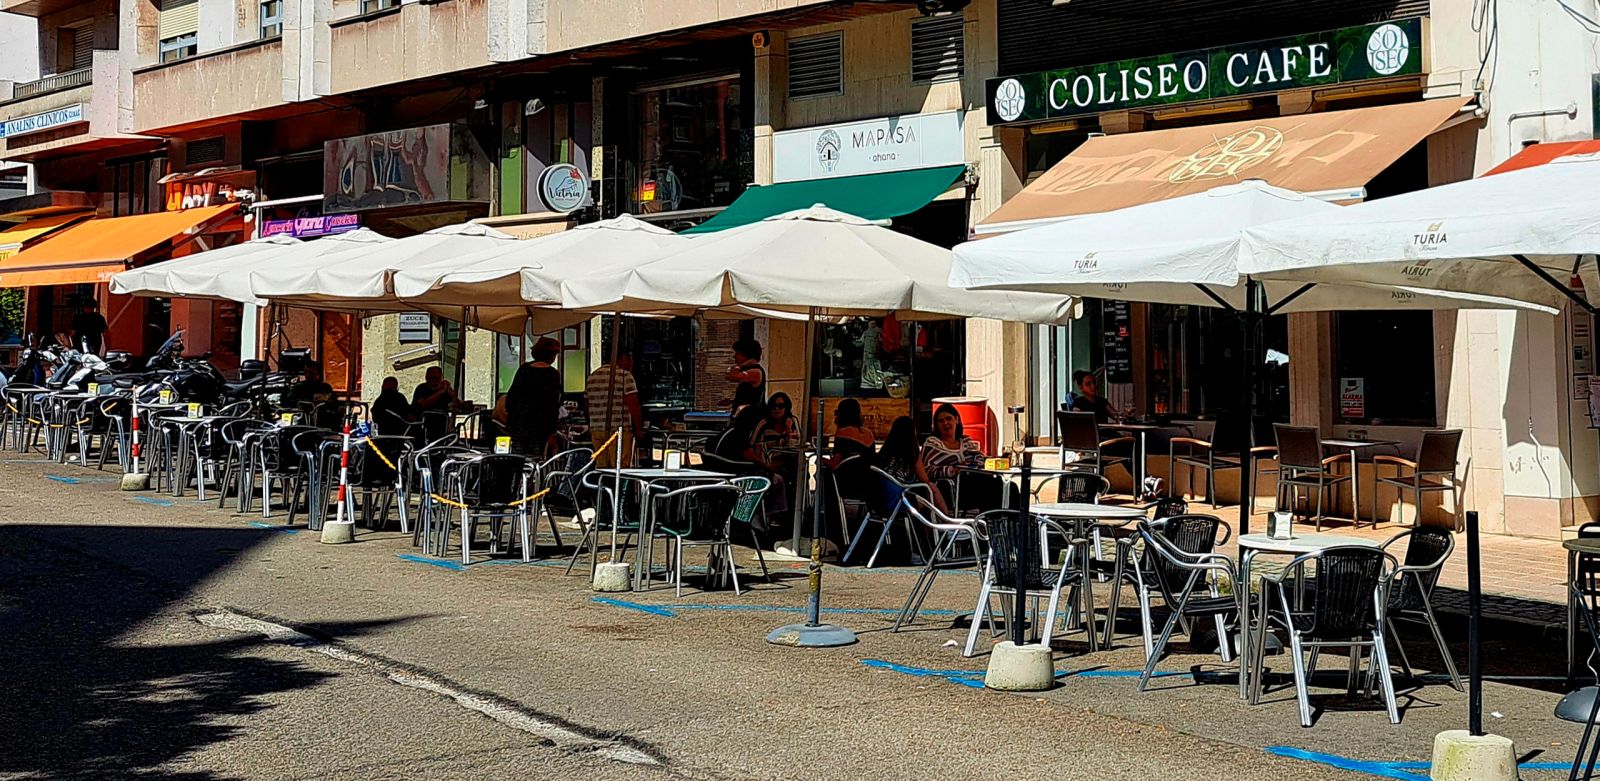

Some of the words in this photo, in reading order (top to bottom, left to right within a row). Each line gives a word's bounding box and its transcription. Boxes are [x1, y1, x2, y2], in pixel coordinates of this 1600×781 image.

[1049, 59, 1208, 110] COLISEO
[1226, 43, 1332, 88] CAFE
[852, 125, 917, 149] MAPASA
[548, 186, 581, 199] Victoria
[1413, 232, 1448, 245] TURIA
[1073, 259, 1098, 269] TURIA
